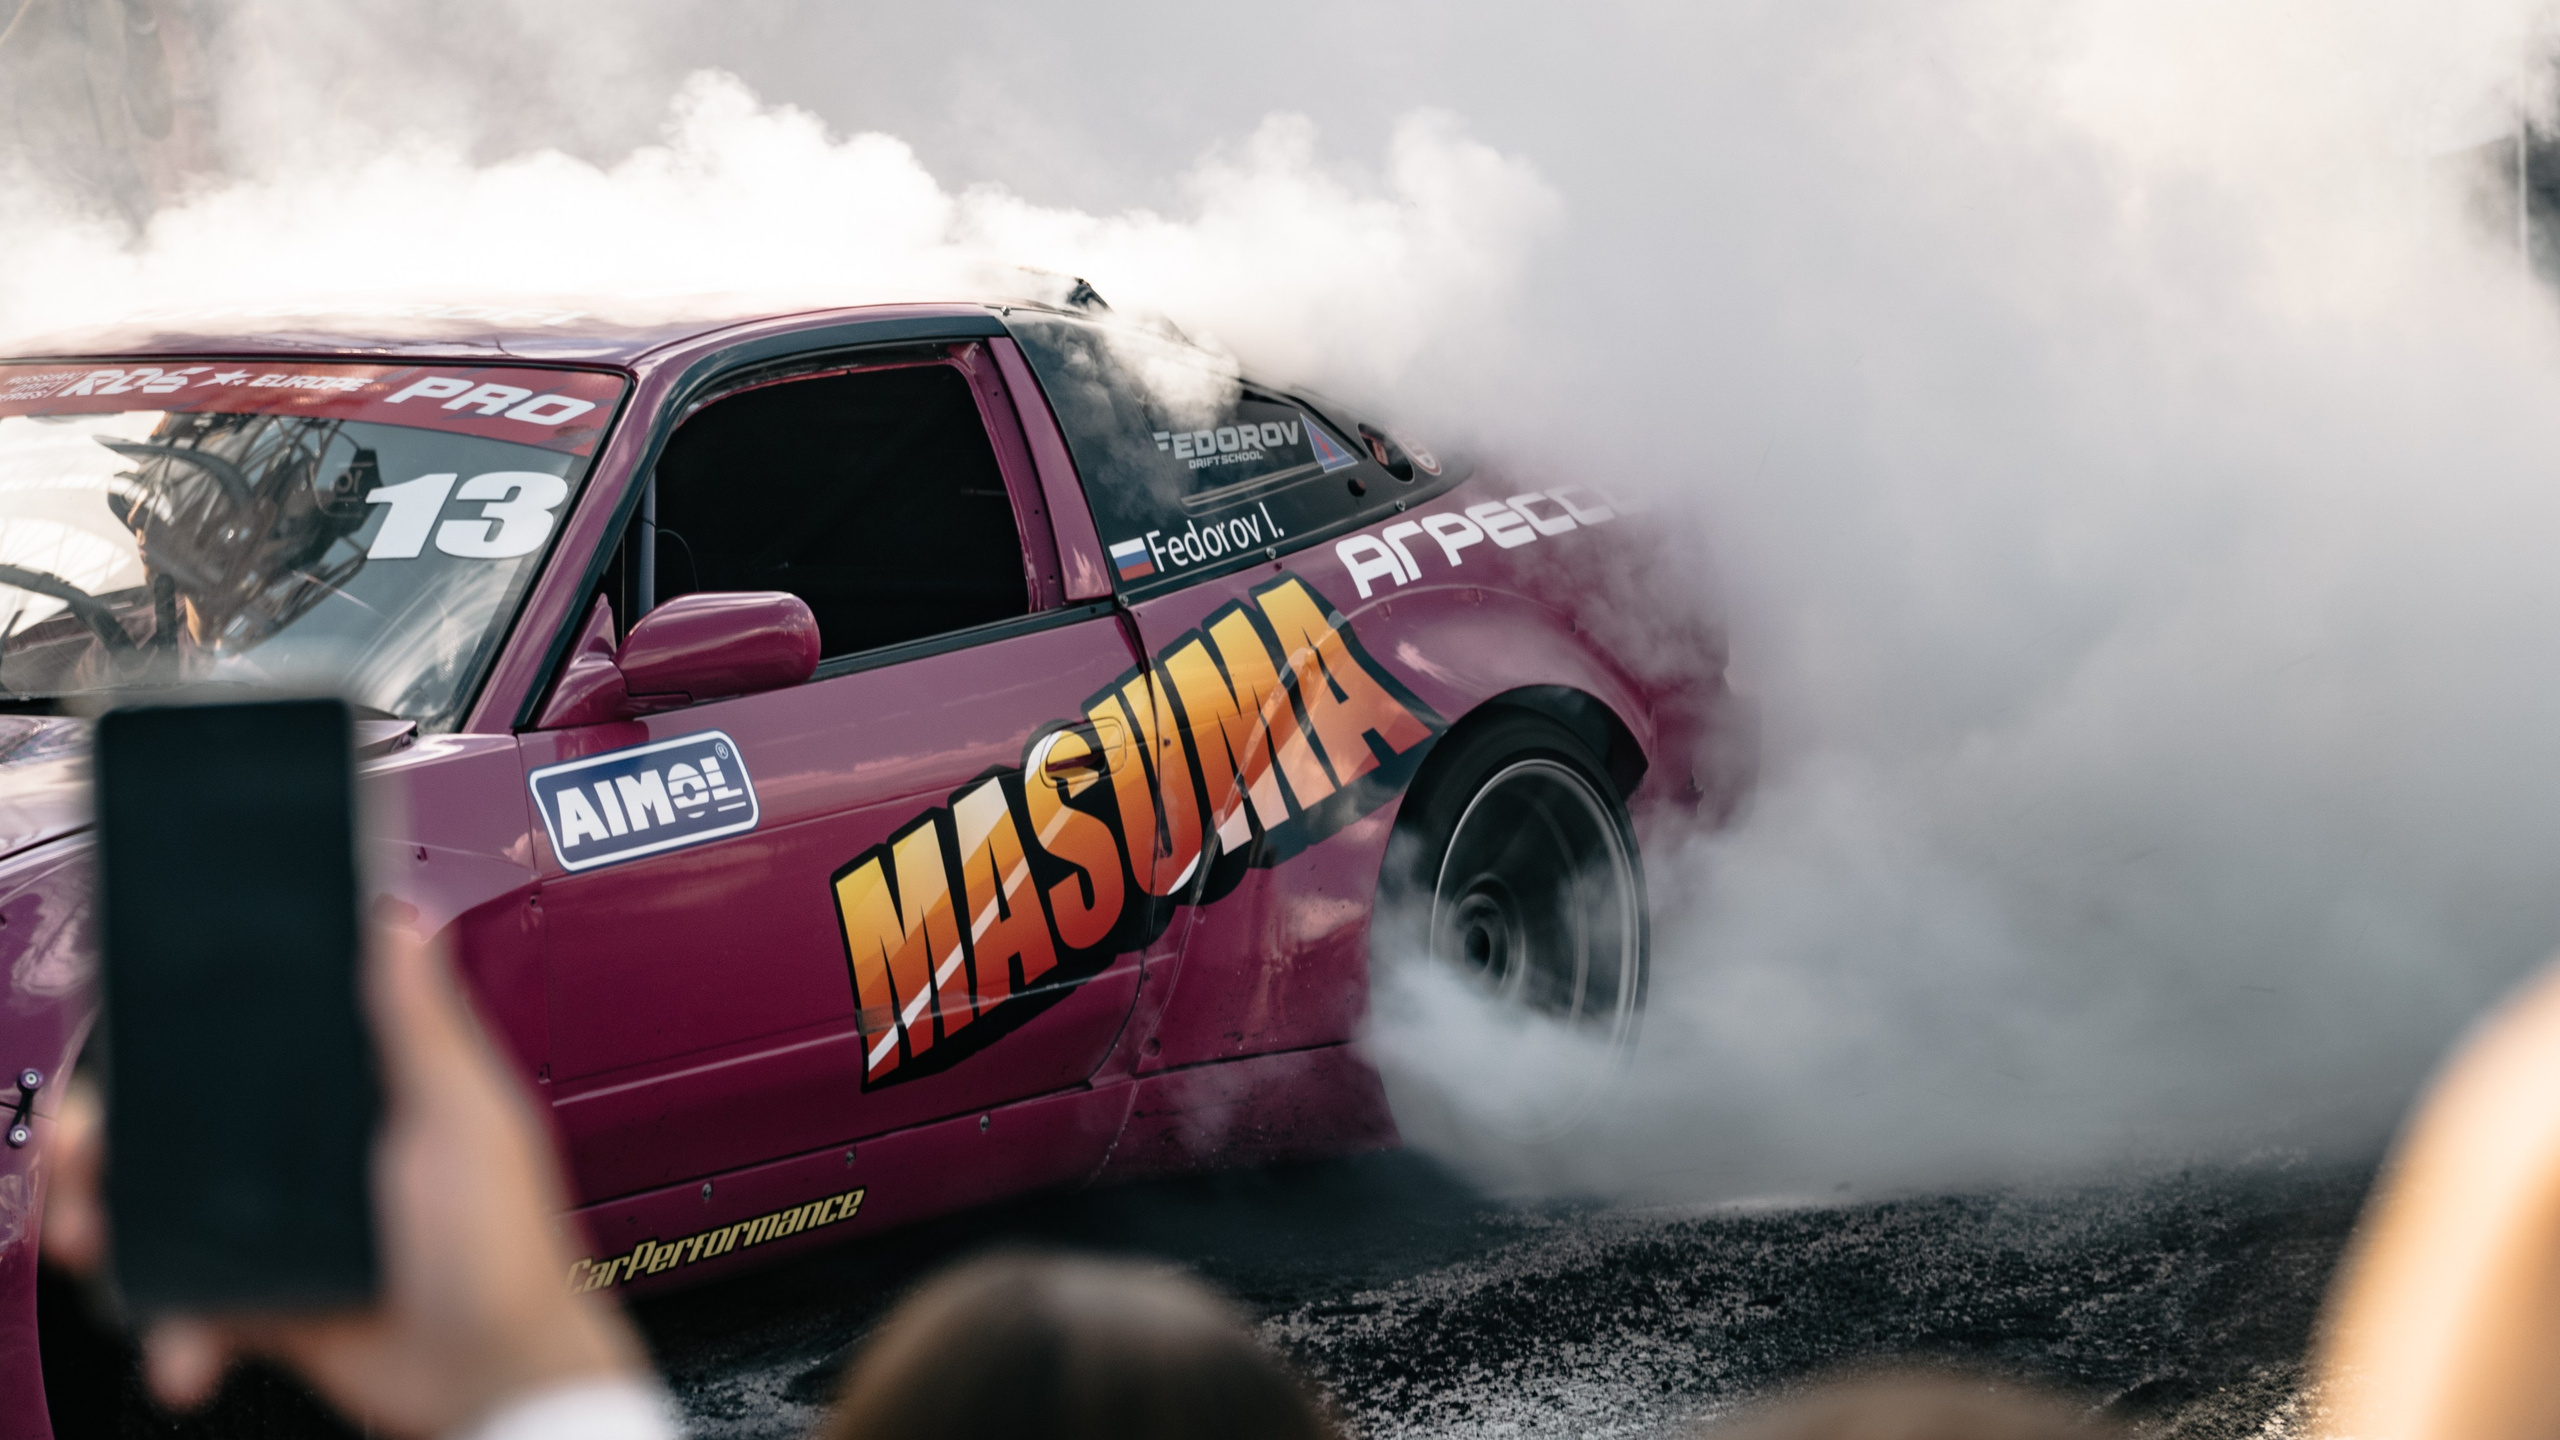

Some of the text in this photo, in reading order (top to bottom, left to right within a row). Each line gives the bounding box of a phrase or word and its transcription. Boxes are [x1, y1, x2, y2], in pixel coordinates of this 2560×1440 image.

[56, 367, 595, 426] RDS EUROPE PRO
[1152, 420, 1299, 460] FEDOROV
[365, 471, 568, 560] 13
[1146, 519, 1262, 573] Fedorov
[1335, 483, 1655, 600] АГРЕСС
[556, 755, 746, 848] AIMOL
[835, 577, 1433, 1084] MASUMA
